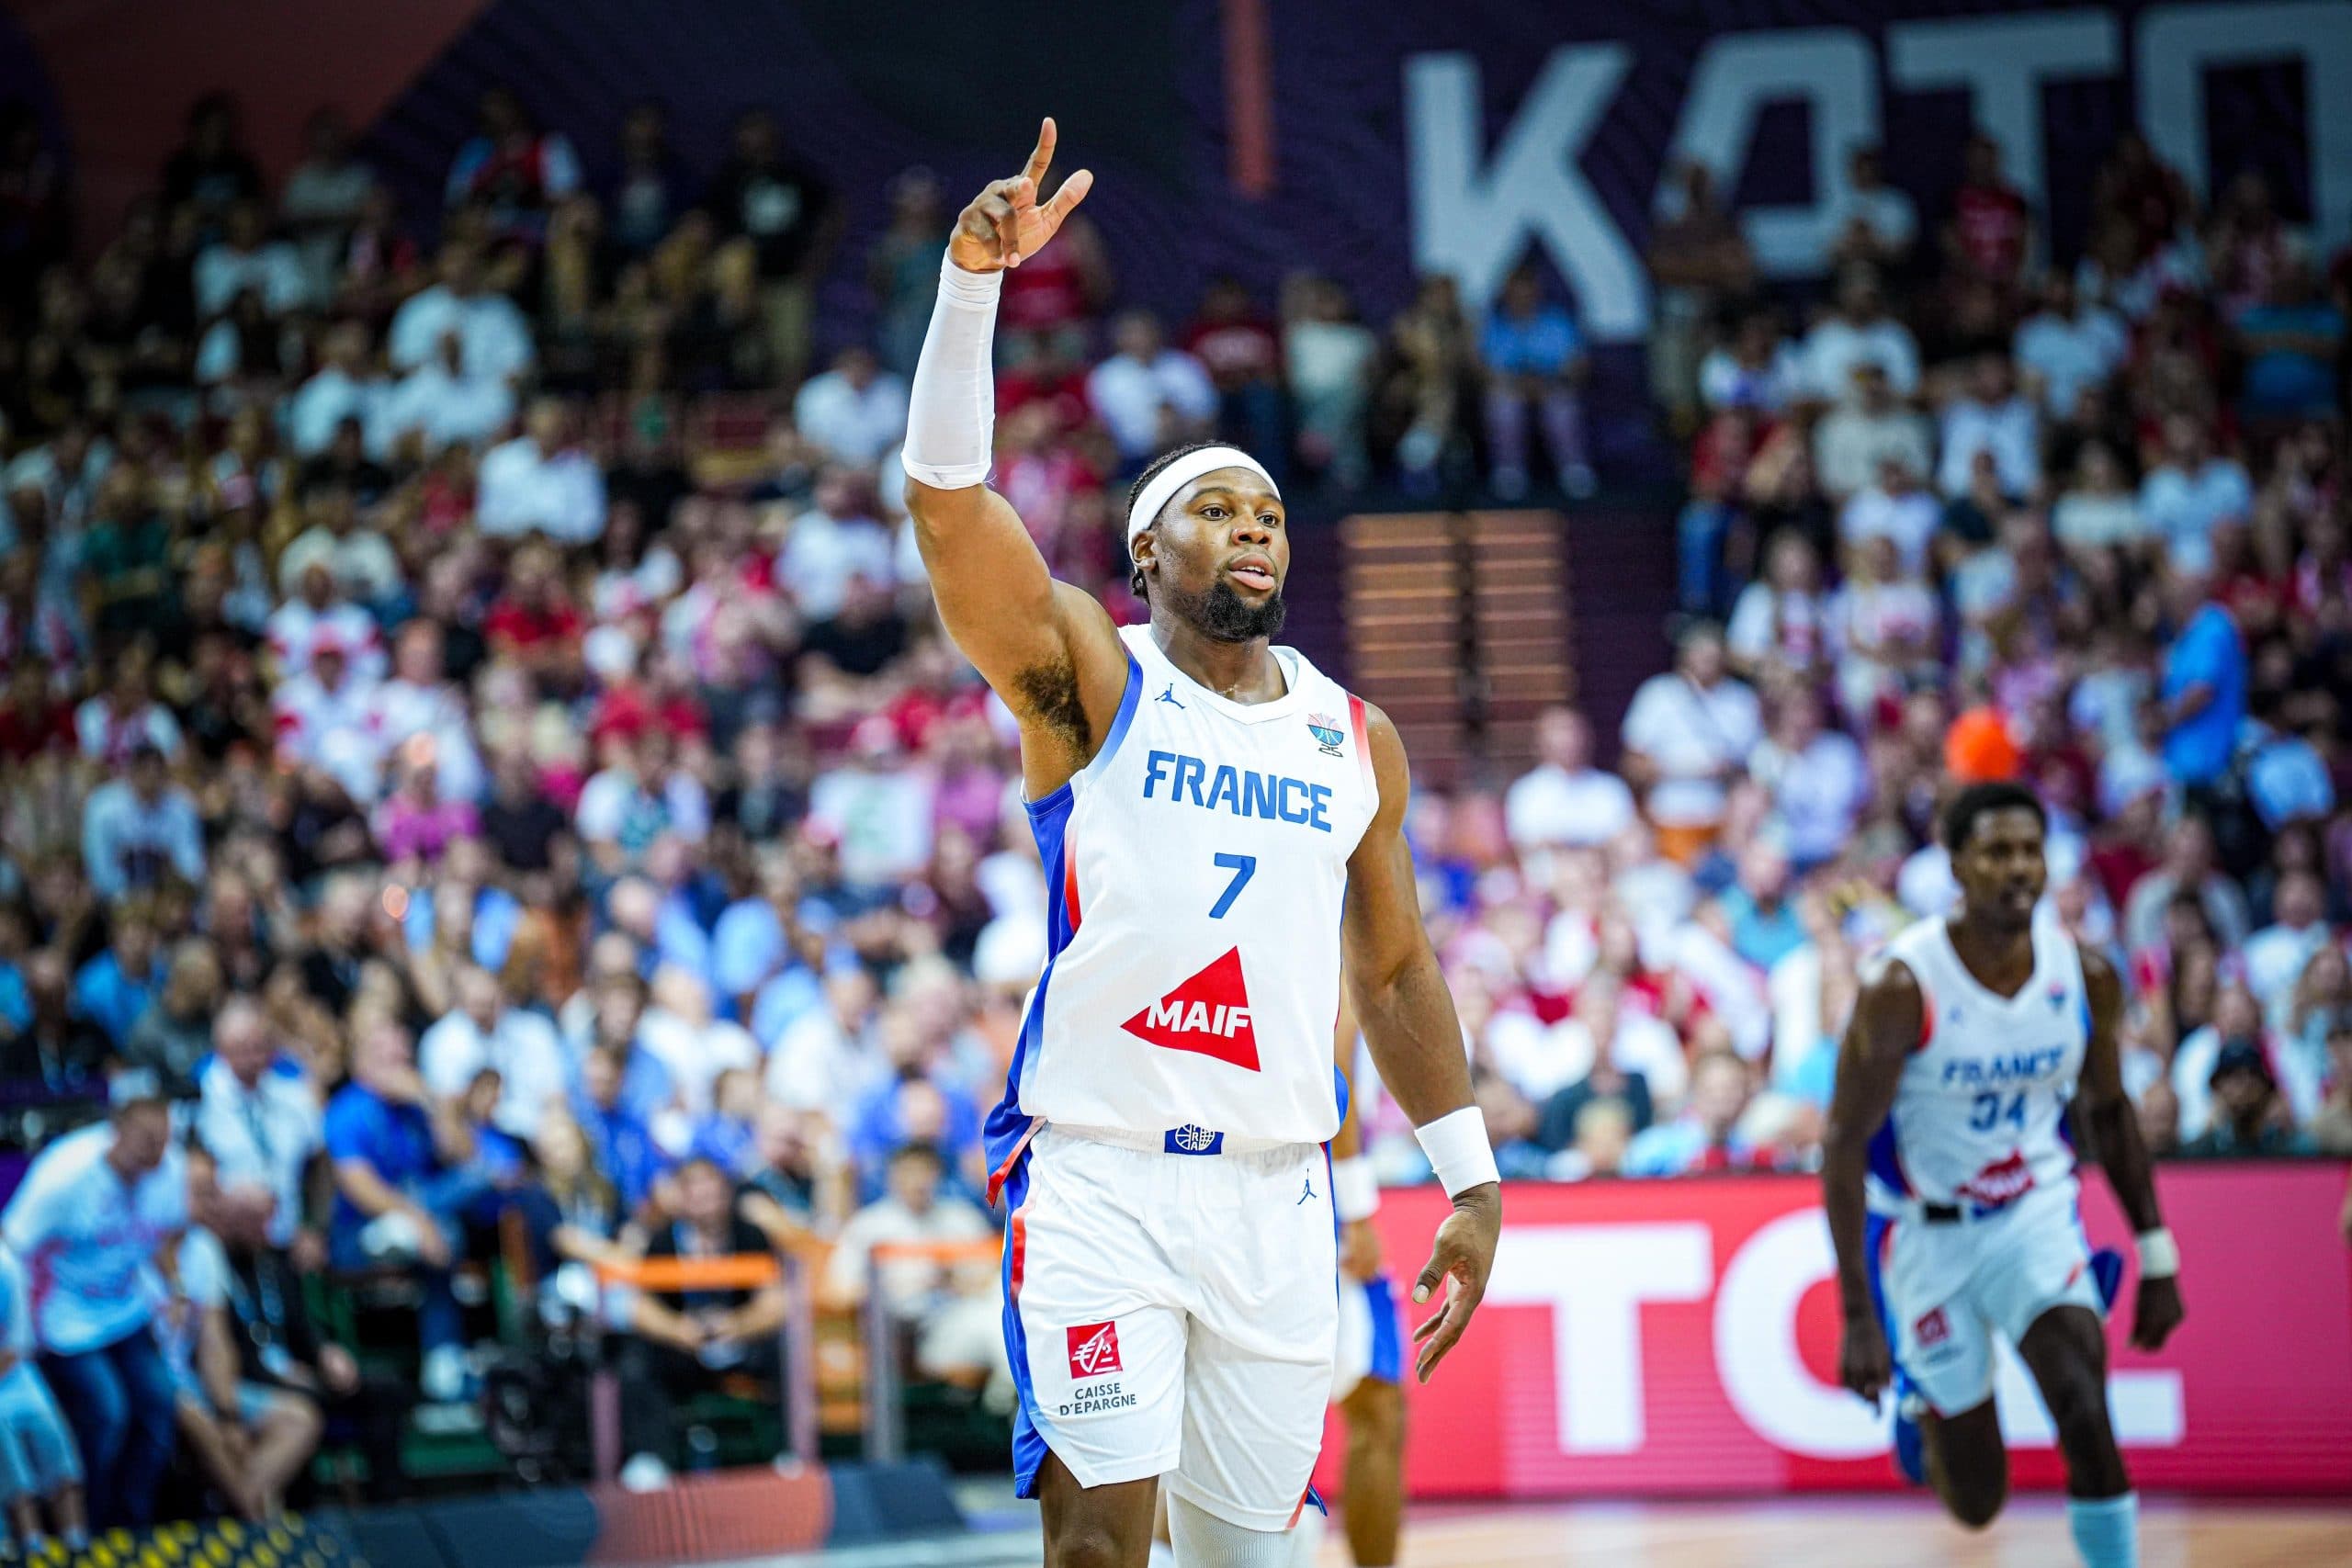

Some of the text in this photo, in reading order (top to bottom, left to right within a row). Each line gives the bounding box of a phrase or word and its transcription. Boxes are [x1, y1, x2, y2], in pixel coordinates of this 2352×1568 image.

[1143, 750, 1332, 833] FRANCE
[1208, 852, 1257, 919] 7
[1146, 998, 1251, 1039] MAIF
[1968, 1088, 2029, 1132] 34
[1059, 1393, 1136, 1416] D'EPARGNE
[1074, 1382, 1122, 1400] CAISSE
